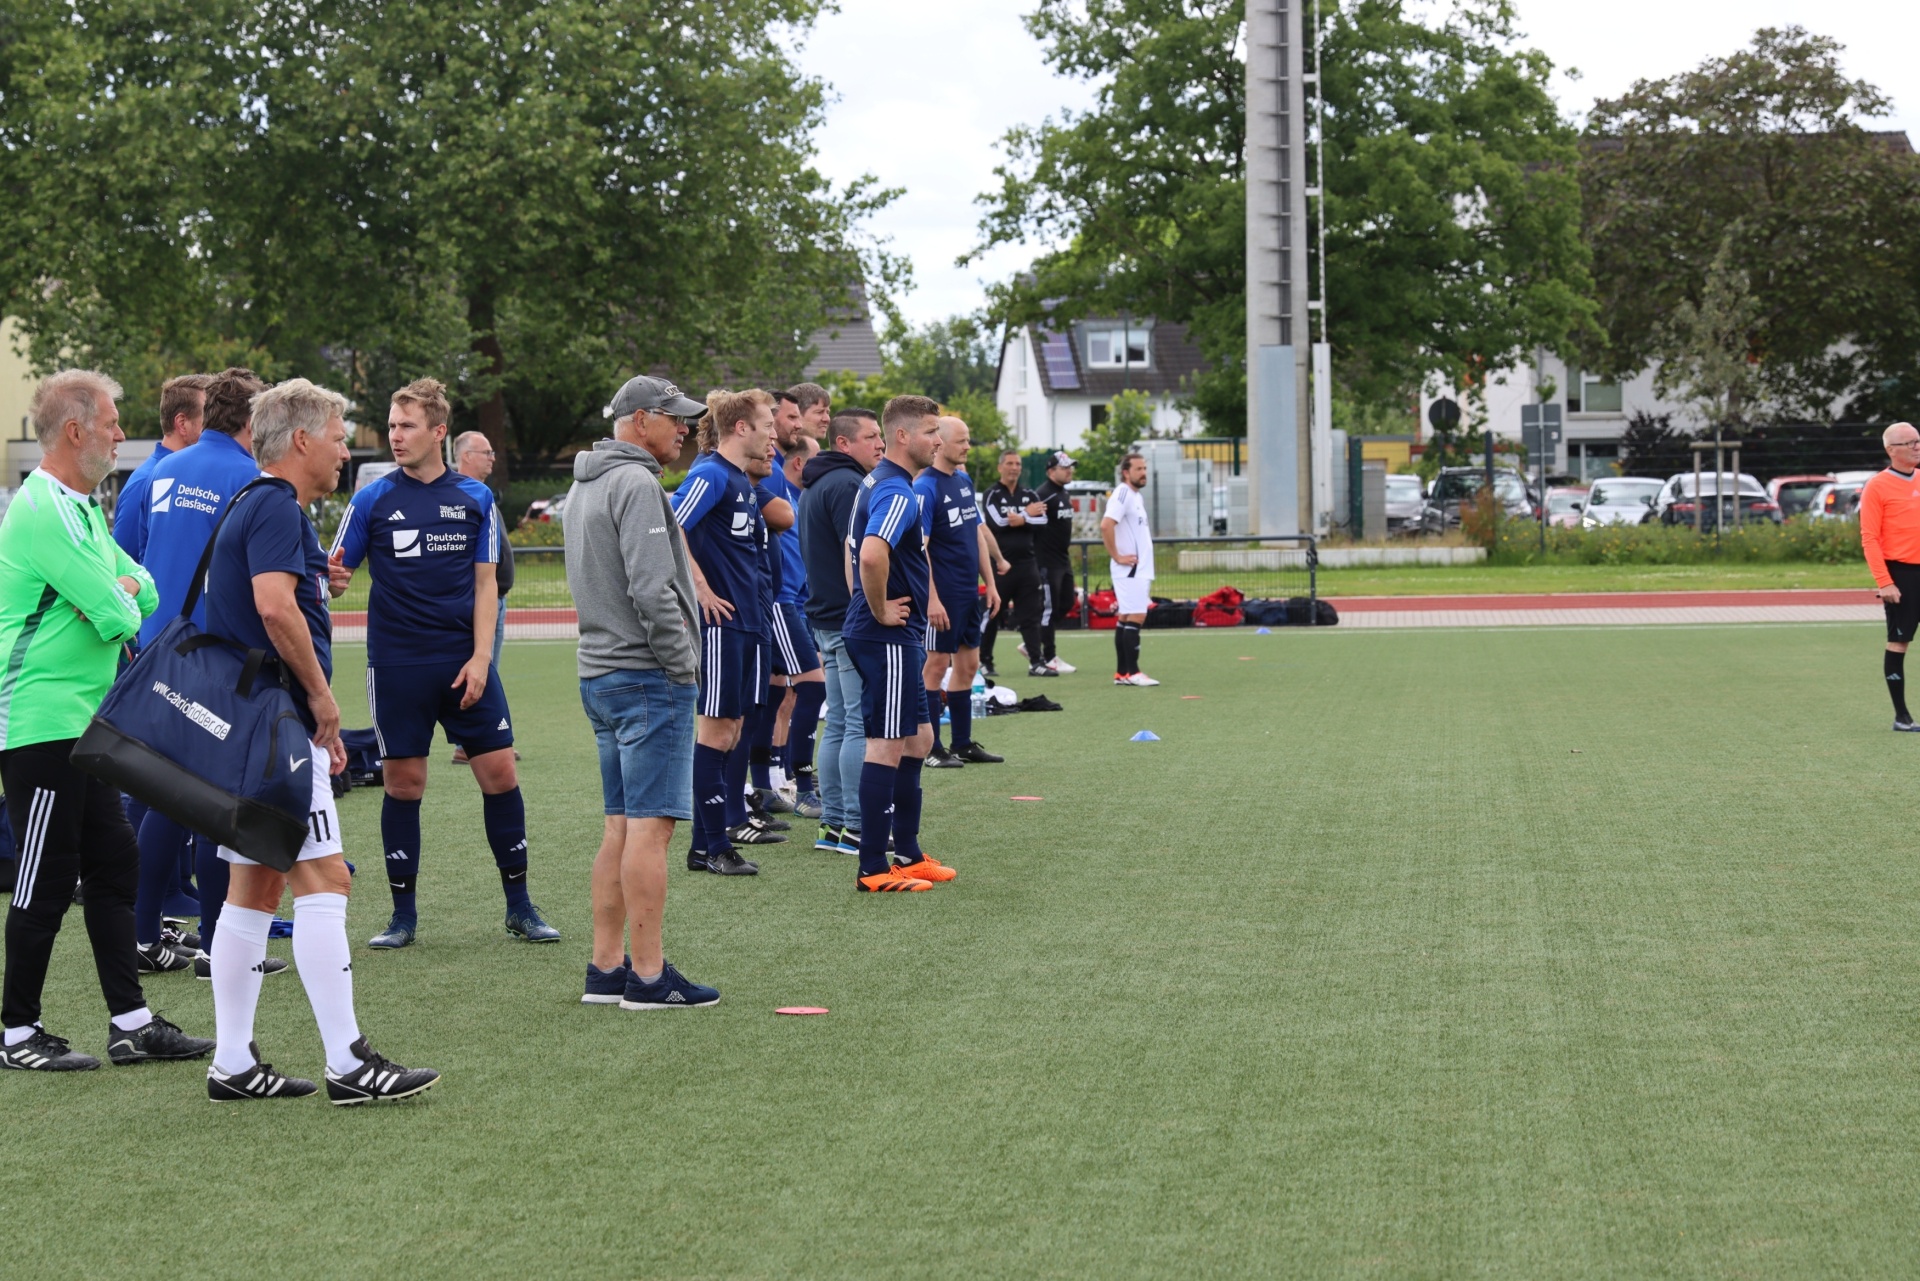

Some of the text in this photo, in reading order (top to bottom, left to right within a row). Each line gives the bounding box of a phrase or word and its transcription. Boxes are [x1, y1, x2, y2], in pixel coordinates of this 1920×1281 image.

[177, 484, 220, 503] Deutsche
[174, 496, 217, 515] Glasfaser
[426, 532, 467, 542] Deutsche
[648, 526, 666, 534] JAKO
[426, 543, 467, 552] Glasfaser
[309, 809, 331, 843] 11
